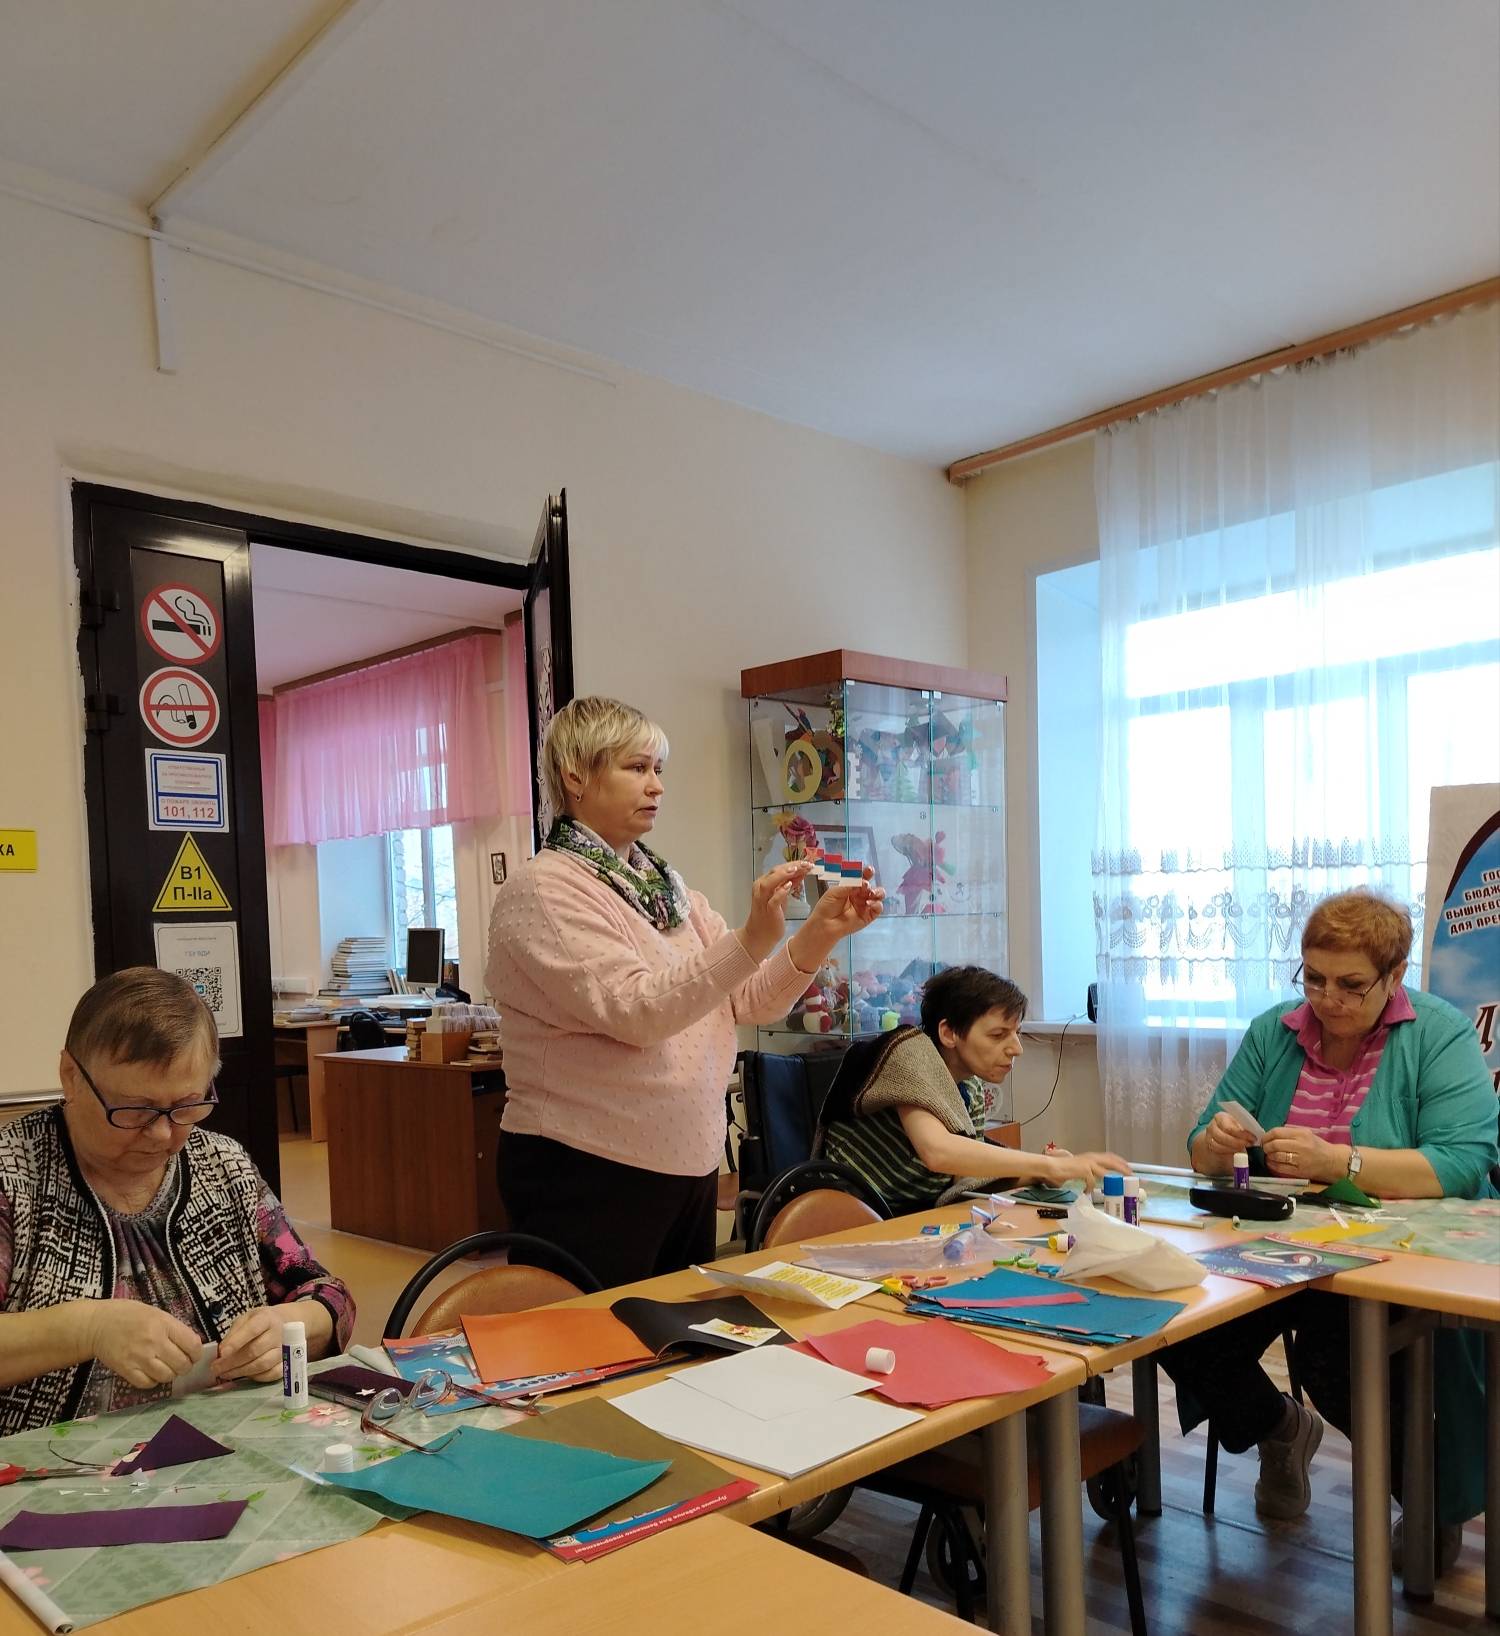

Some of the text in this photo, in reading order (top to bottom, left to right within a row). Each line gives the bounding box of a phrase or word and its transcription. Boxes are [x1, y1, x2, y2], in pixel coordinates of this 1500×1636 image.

[181, 866, 201, 880] В1
[1450, 914, 1500, 935] ДЛЯ ПРЕ
